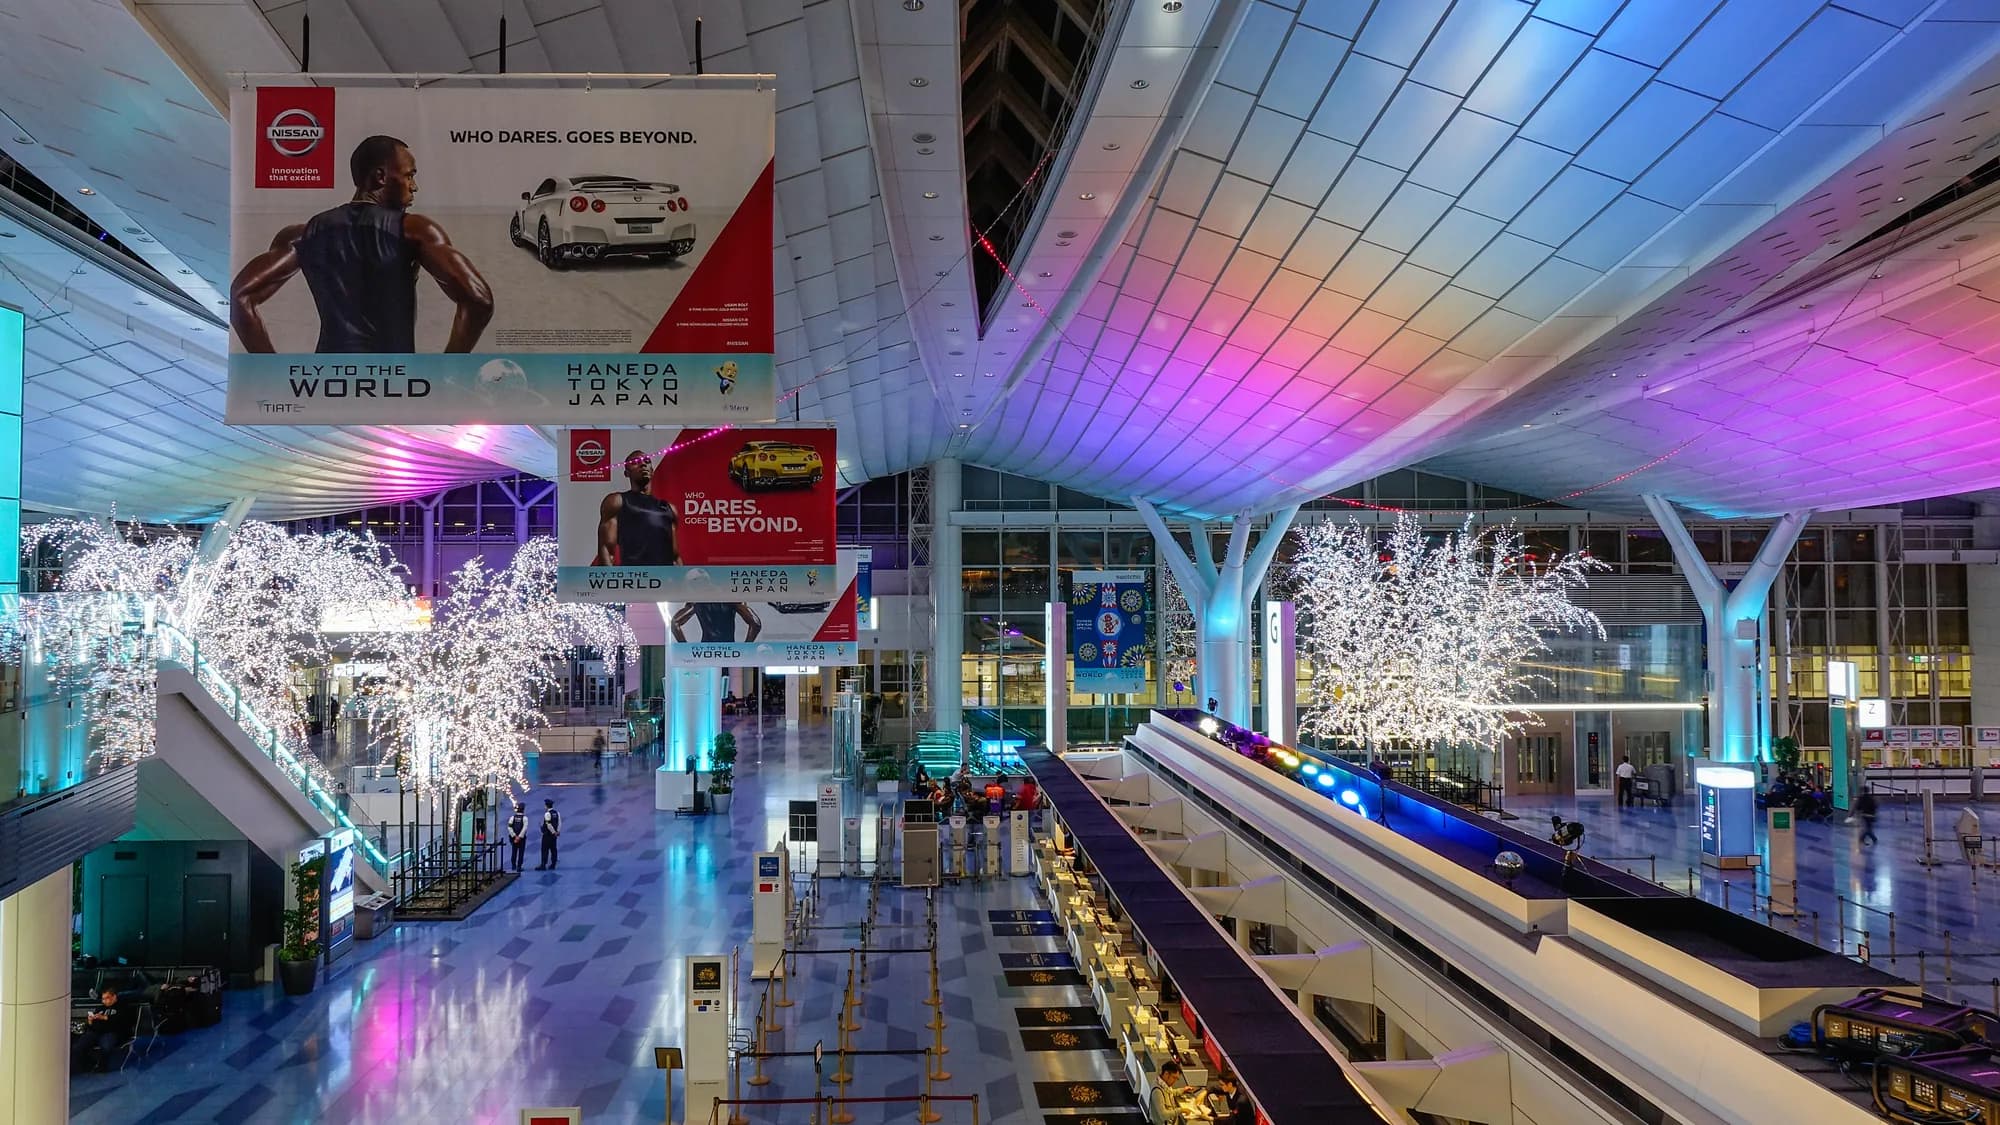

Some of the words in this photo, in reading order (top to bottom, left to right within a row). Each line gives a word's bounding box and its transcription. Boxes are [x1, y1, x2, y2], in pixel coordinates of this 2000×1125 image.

[271, 129, 319, 137] NISSAN
[450, 130, 493, 143] WHO
[498, 130, 562, 143] DARES.
[566, 130, 615, 143] GOES
[619, 131, 697, 144] BEYOND.
[289, 365, 325, 376] FLY
[332, 365, 357, 376] TO
[366, 365, 406, 376] THE
[567, 363, 677, 375] HANEDA
[289, 378, 431, 398] WORLD
[568, 378, 678, 391] TOKYO
[568, 393, 678, 406] JAPAN
[684, 491, 705, 499] WHO
[684, 499, 762, 515] DARES.
[684, 517, 708, 525] GOES
[707, 517, 803, 533] BEYOND.
[588, 578, 662, 589] WORLD
[731, 577, 788, 585] TOKYO
[731, 585, 788, 593] JAPAN
[1270, 612, 1278, 644] G
[692, 650, 741, 658] WORLD
[1868, 703, 1876, 715] Z
